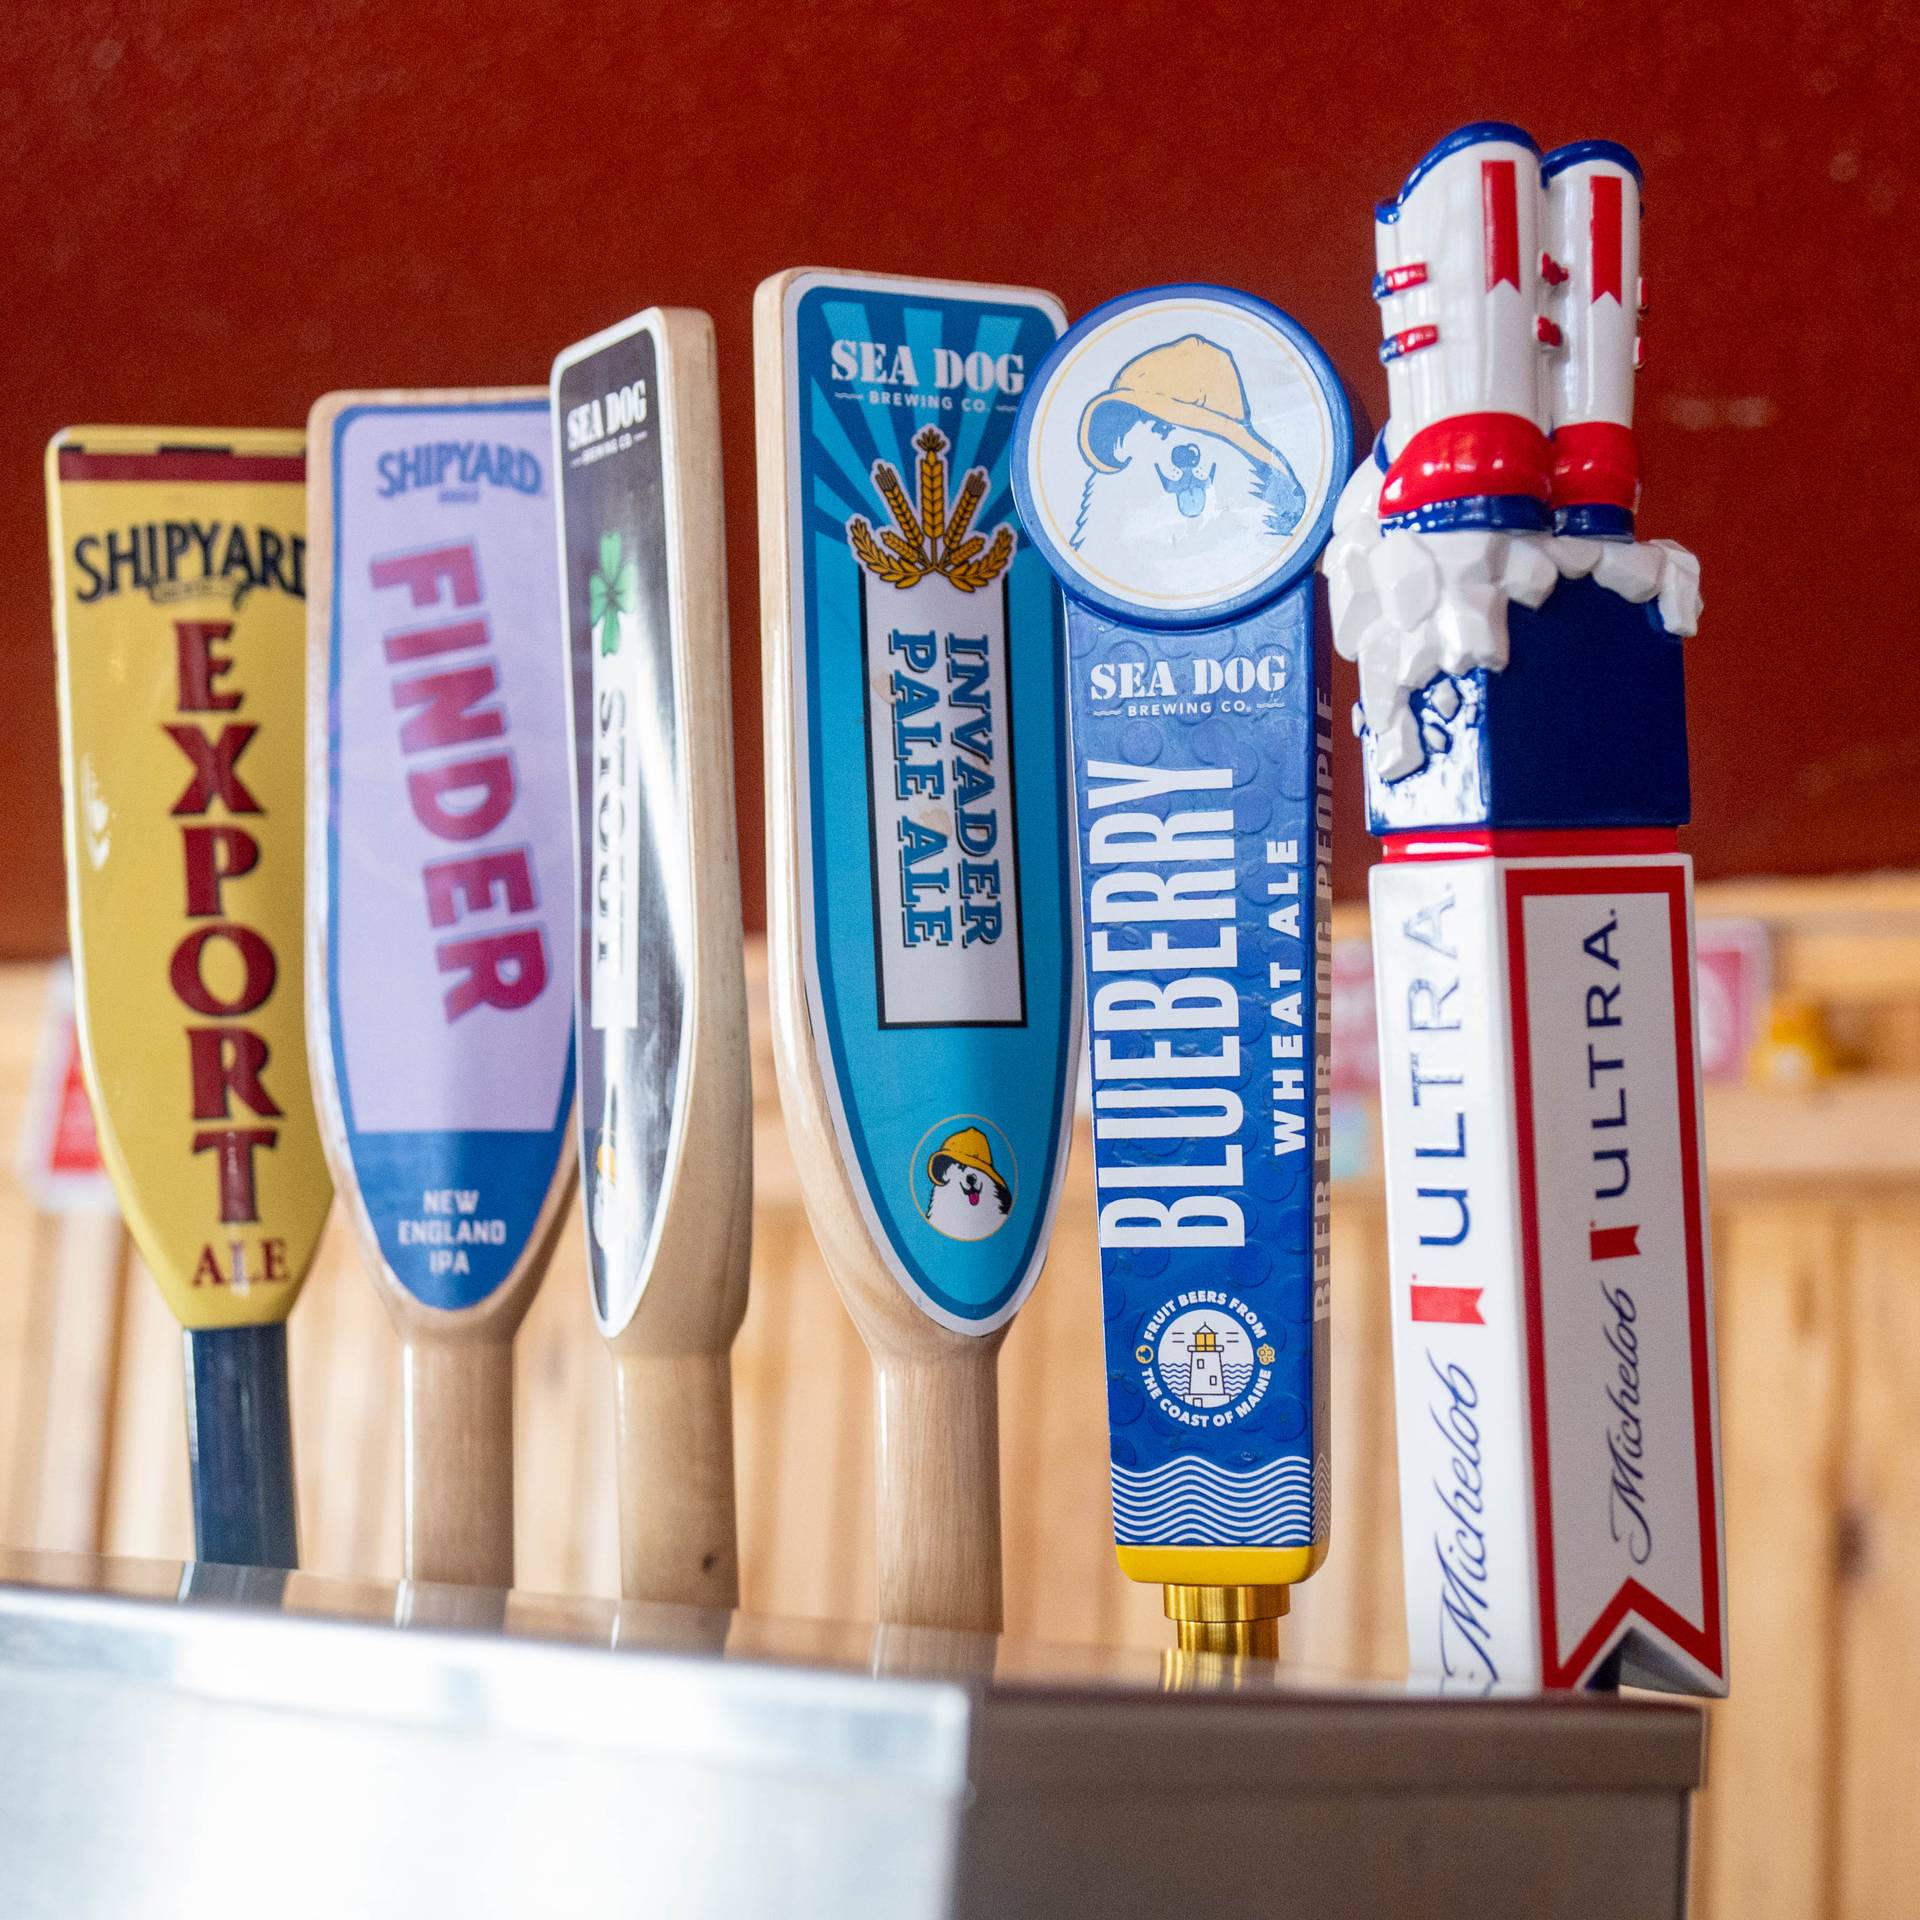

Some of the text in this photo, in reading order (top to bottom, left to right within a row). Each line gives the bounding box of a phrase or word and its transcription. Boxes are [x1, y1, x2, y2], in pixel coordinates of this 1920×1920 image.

[831, 339, 1024, 395] SEA DOG
[567, 379, 647, 451] SEA DOG
[869, 391, 953, 409] BREWING
[377, 439, 542, 497] SHIPYARD
[1090, 655, 1287, 700] SEA DOG
[1128, 702, 1212, 717] BREWING
[369, 535, 548, 1025] FINDER
[888, 629, 953, 947] PALE ALE
[945, 632, 1002, 948] INVADER
[160, 618, 285, 1224] EXPORT
[1087, 760, 1245, 1248] BLUEBERRY
[1267, 839, 1306, 1156] WHEAT ALE
[423, 1189, 479, 1214] NEW
[398, 1219, 506, 1245] ENGLAND
[192, 1236, 290, 1288] ALE
[429, 1250, 470, 1275] IPA
[1144, 1290, 1267, 1341] FRUIT BEERS FROM
[1142, 1368, 1272, 1428] THE COAST OF MAINE
[1601, 1279, 1652, 1565] Michelob
[1425, 1347, 1499, 1684] Michelob
